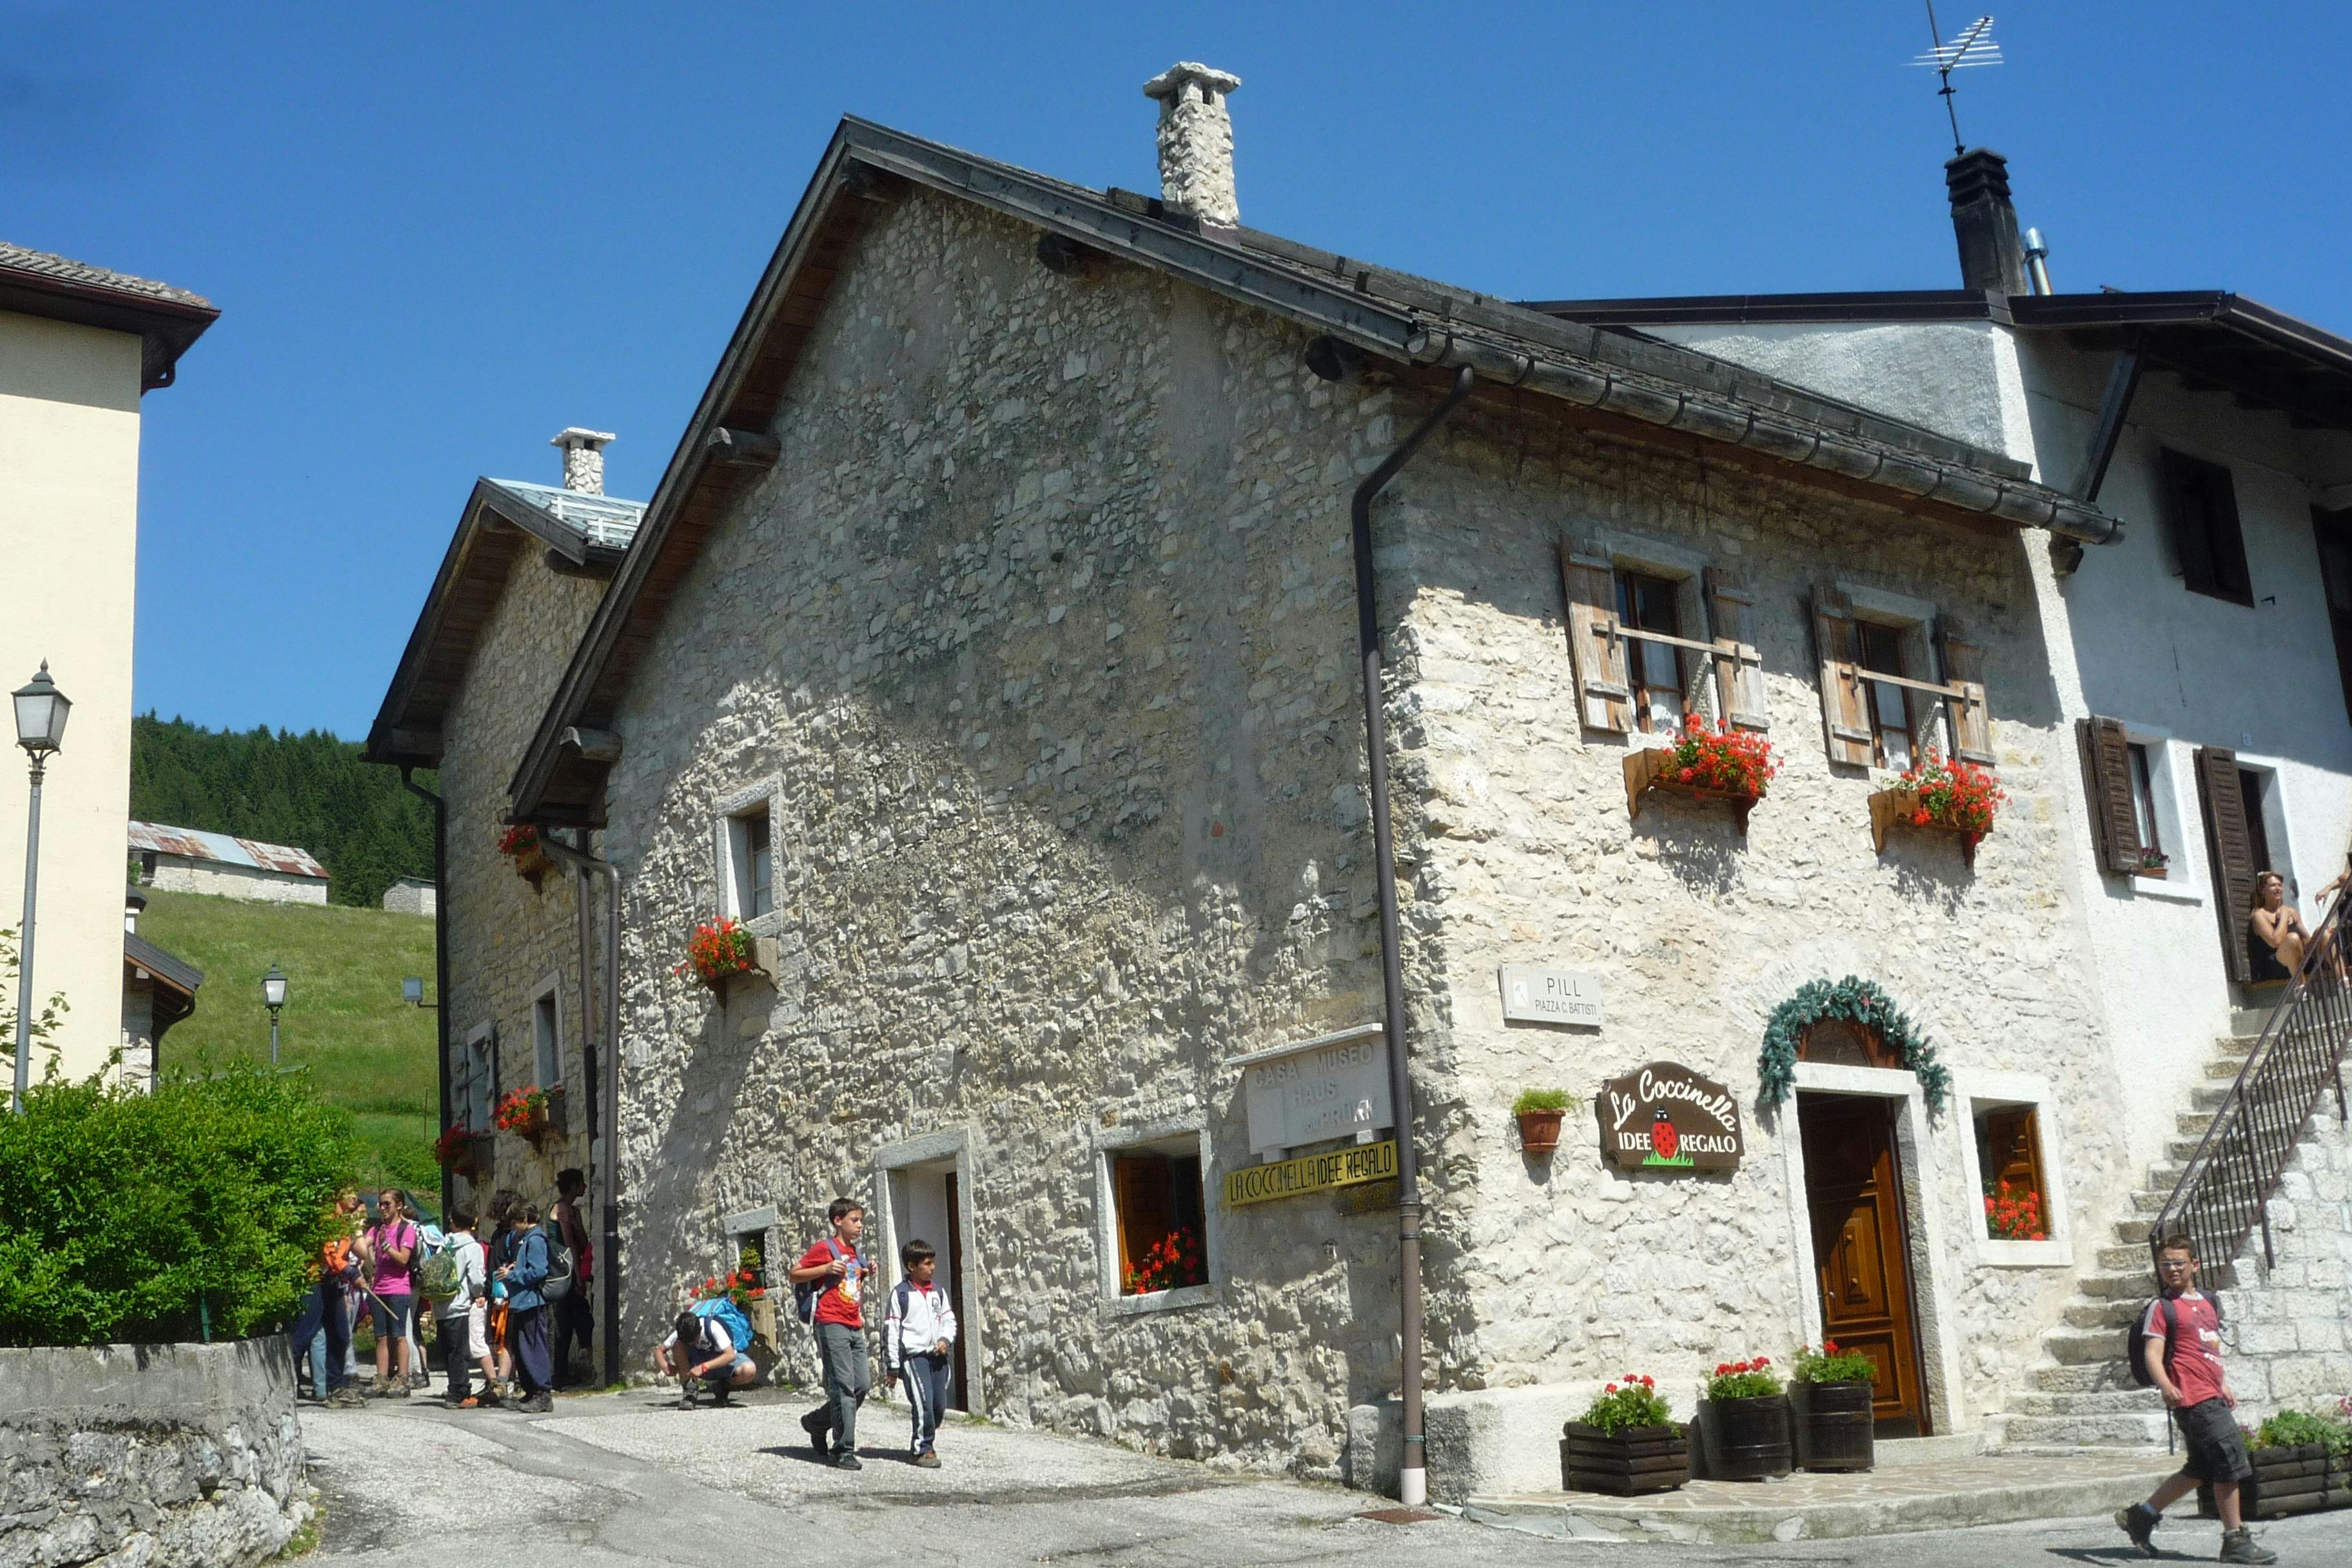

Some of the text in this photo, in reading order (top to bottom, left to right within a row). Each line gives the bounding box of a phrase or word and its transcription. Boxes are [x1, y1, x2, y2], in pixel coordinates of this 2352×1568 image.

[1547, 977, 1581, 997] PILL
[1535, 999, 1597, 1015] PIAZZA C. BATTISTI
[1255, 1043, 1373, 1088] CASA MUSEO
[1293, 1079, 1337, 1108] HAUS
[1611, 1069, 1736, 1132] La Coccinella
[1618, 1132, 1736, 1153] IDEE REGALO
[1230, 1144, 1391, 1202] LA COCCINELLA IDEE REGALO
